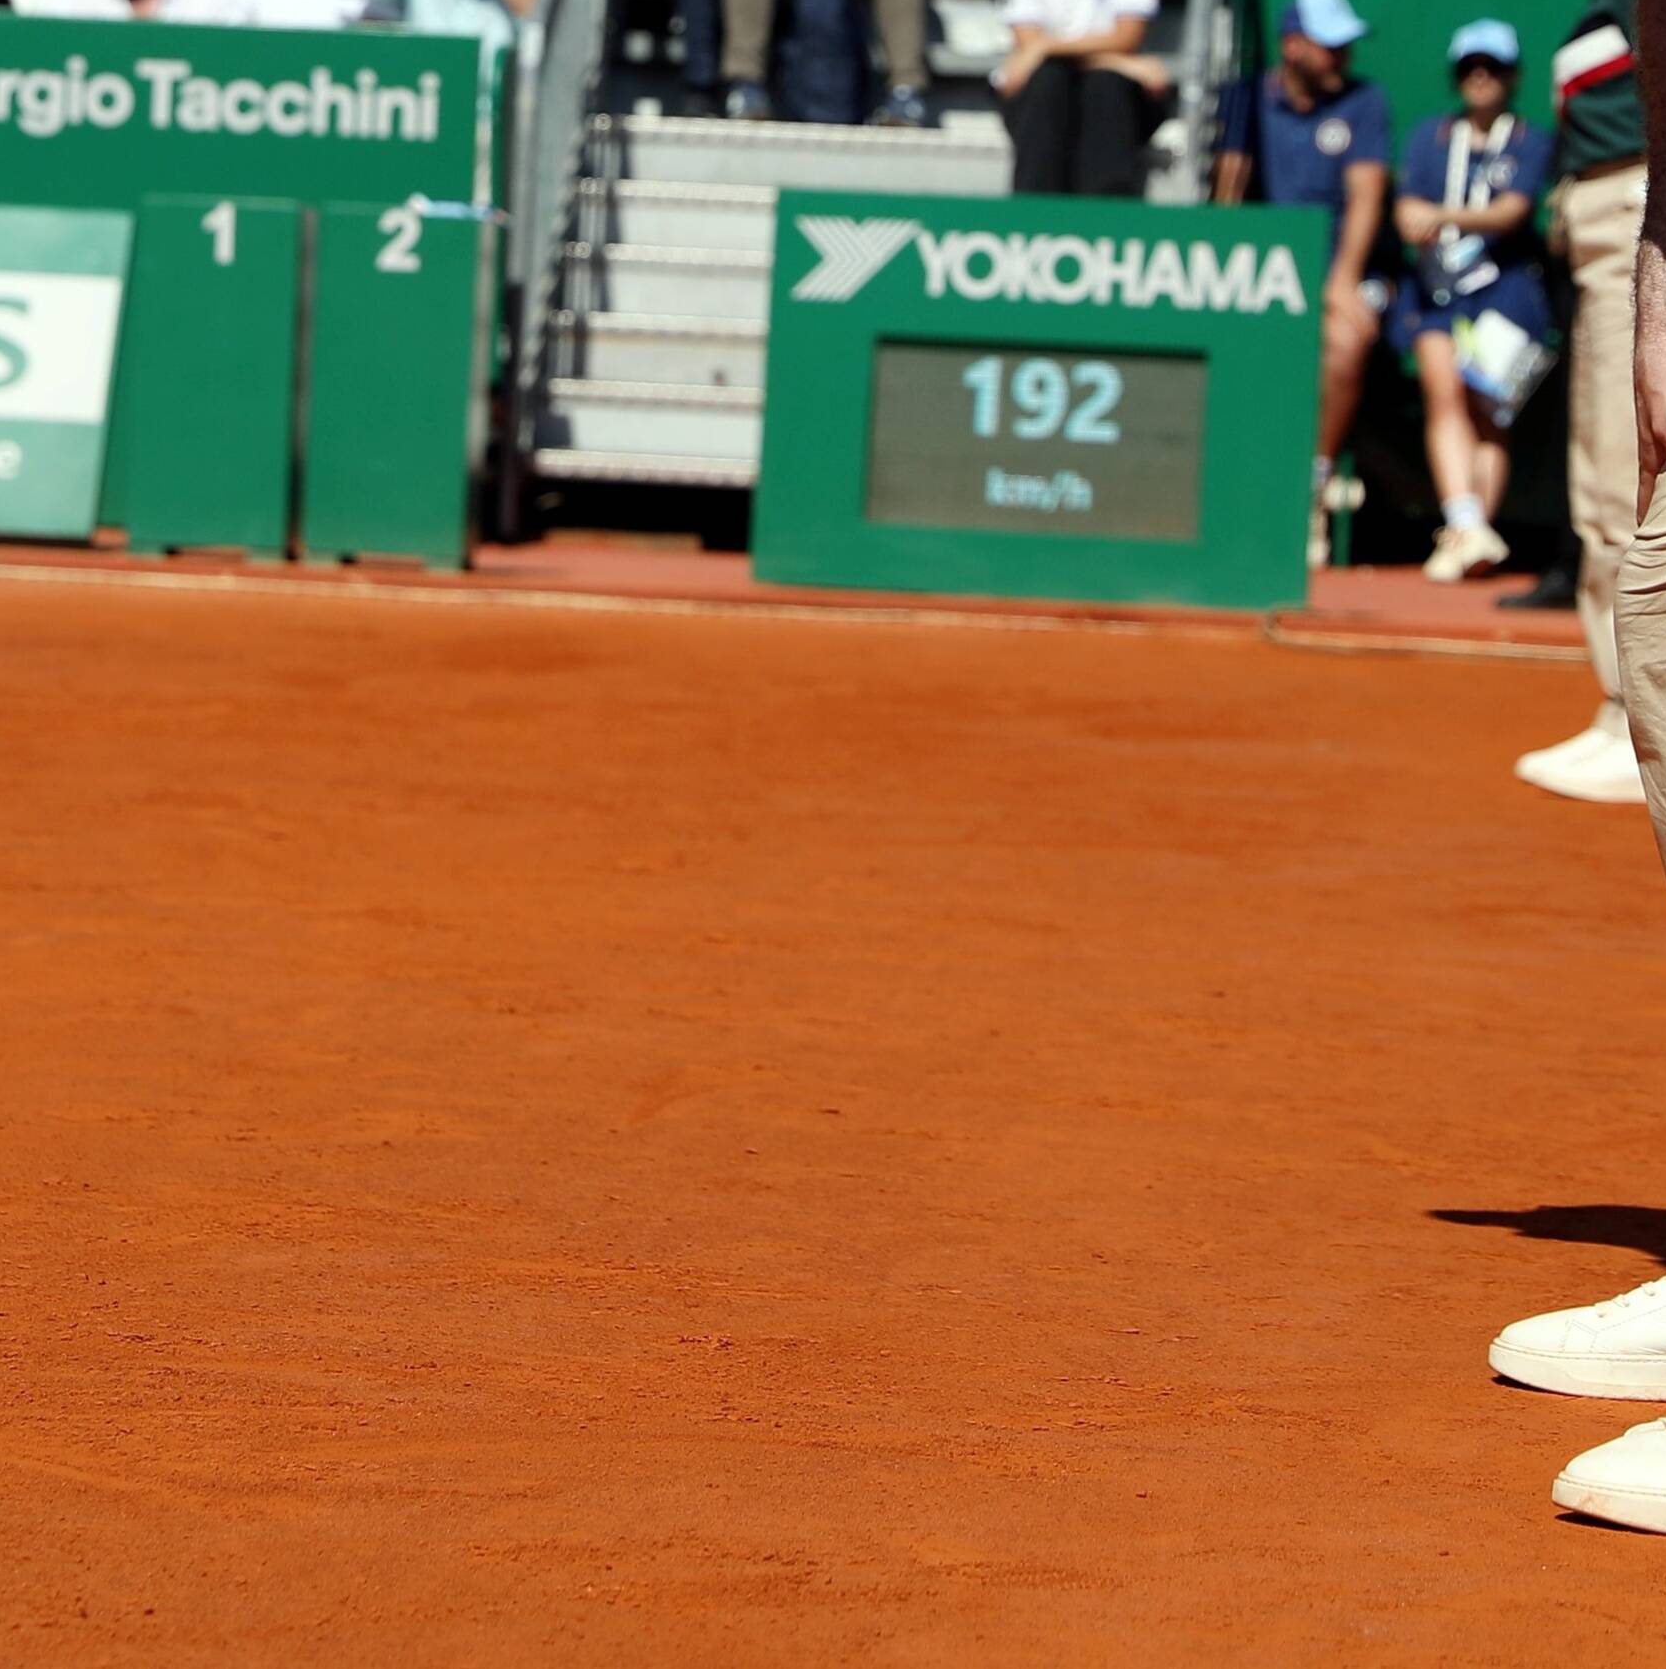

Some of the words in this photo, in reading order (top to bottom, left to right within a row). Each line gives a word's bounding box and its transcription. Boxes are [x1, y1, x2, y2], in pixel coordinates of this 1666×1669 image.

[133, 58, 440, 142] Tacchini
[201, 201, 238, 266] 1
[374, 205, 421, 274] 2
[916, 230, 1307, 315] YOKOHAMA
[962, 355, 1124, 443] 192
[983, 466, 1093, 513] km/h
